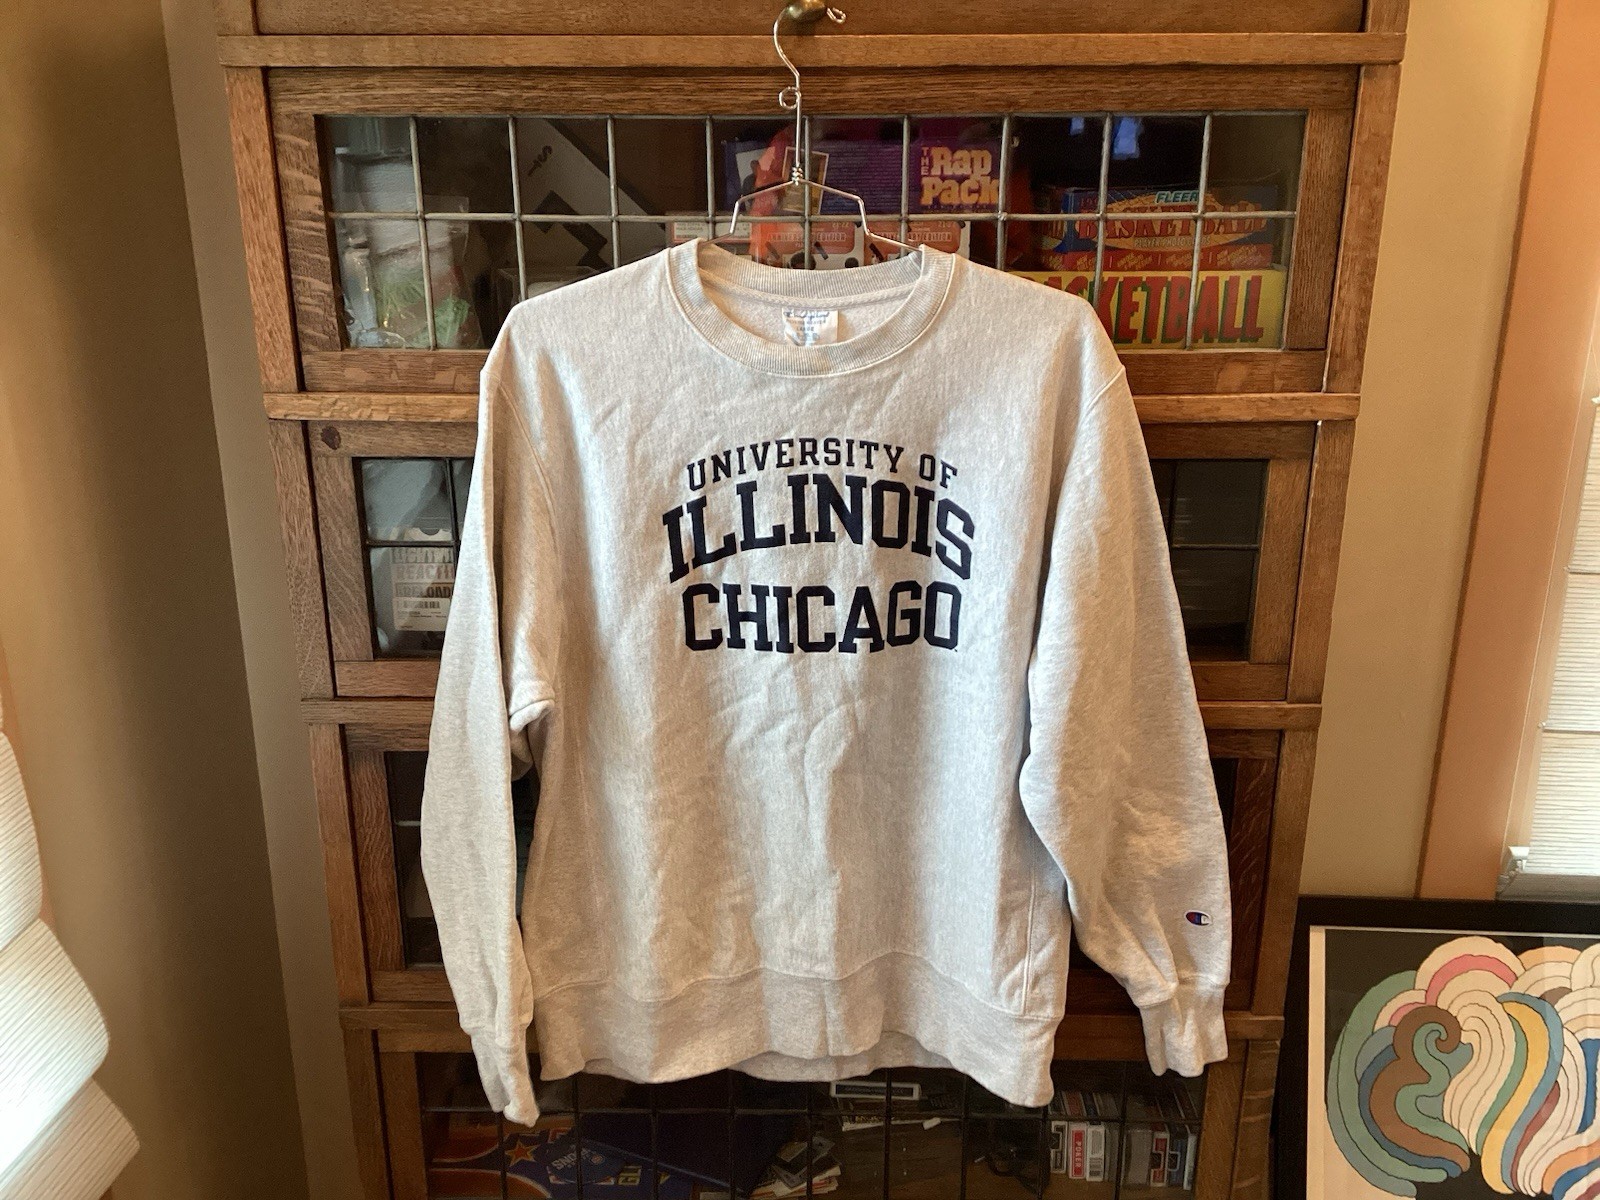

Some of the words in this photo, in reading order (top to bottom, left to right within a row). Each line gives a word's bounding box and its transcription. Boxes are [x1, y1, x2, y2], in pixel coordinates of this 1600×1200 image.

[921, 147, 930, 176] THE
[930, 146, 992, 177] Rap
[1048, 275, 1265, 344] KETBALL
[687, 437, 905, 491] UNIVERSITY
[919, 453, 958, 489] OF
[662, 473, 975, 584] ILLINOIS
[682, 580, 962, 654] CHICAGO
[1074, 1141, 1083, 1168] POKER
